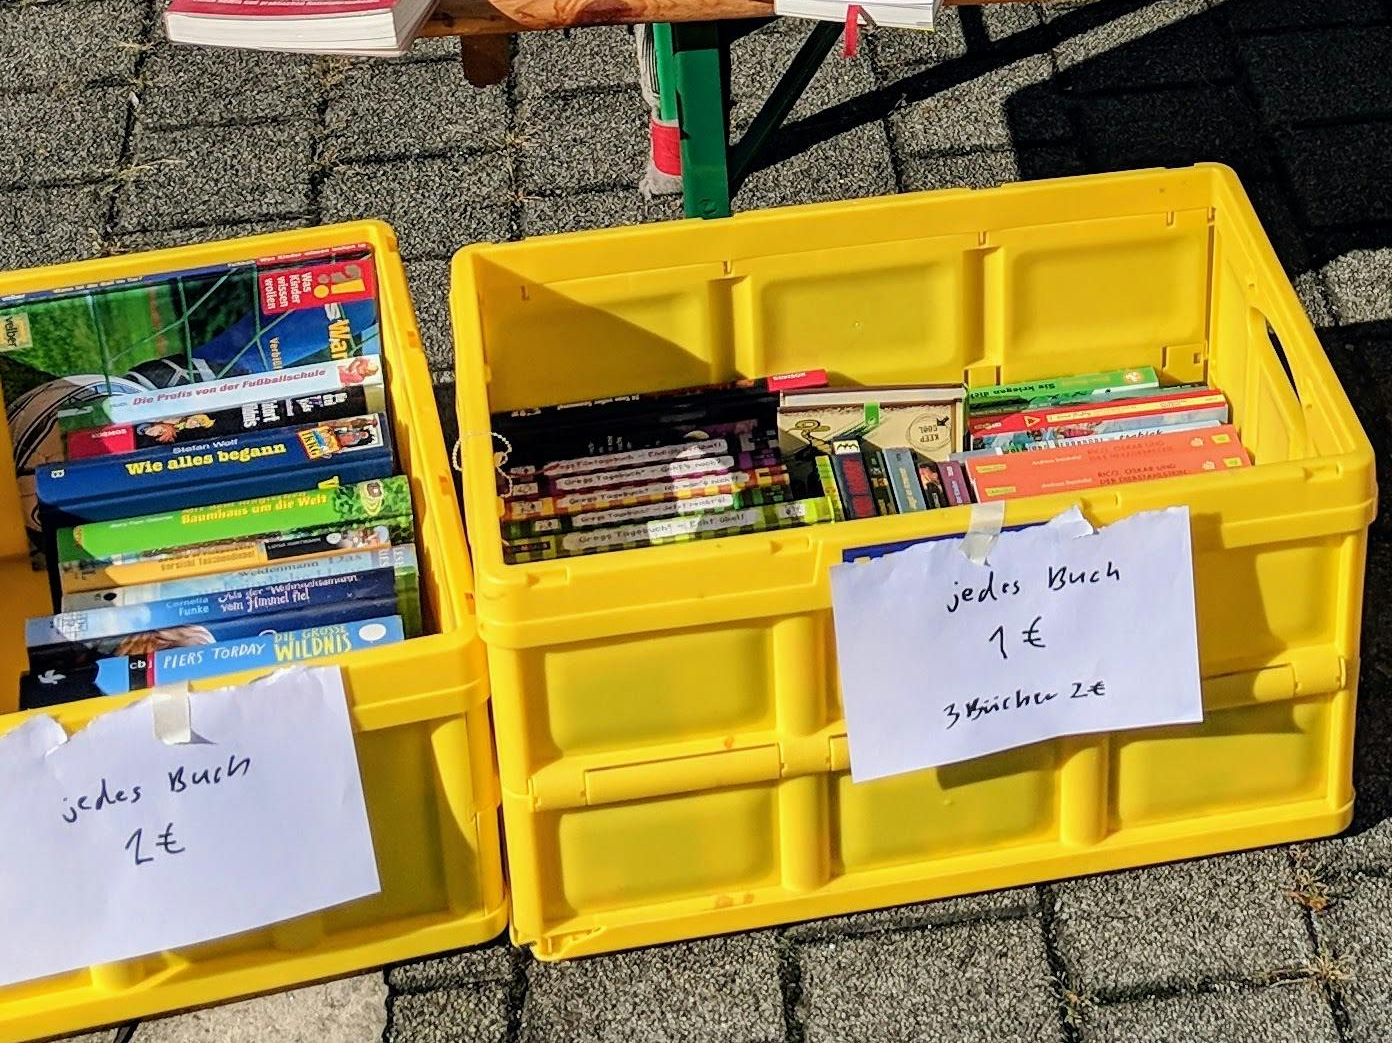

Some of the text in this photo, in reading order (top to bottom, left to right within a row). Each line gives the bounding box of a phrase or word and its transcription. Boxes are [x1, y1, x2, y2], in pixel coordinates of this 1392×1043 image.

[264, 277, 278, 310] wollen
[276, 276, 289, 308] wissen
[289, 274, 302, 304] Kinder
[301, 271, 313, 293] Was
[132, 368, 327, 407] Die Profis von der Fußballschule
[126, 442, 287, 476] Wie alles begann
[173, 439, 238, 454] Stefan Wolf
[182, 508, 249, 524] Baumhaus
[252, 503, 272, 515] um
[275, 498, 296, 511] die
[298, 493, 328, 507] Welt
[221, 588, 311, 614] vom Himmel fiel
[947, 560, 1121, 613] jedes Buch
[179, 605, 210, 618] Funke
[274, 633, 352, 662] WILDNIS
[1022, 616, 1047, 648] €
[163, 642, 266, 669] PIERS TORDAY
[966, 687, 1058, 723] Bücher
[62, 755, 251, 824] jedes Buch
